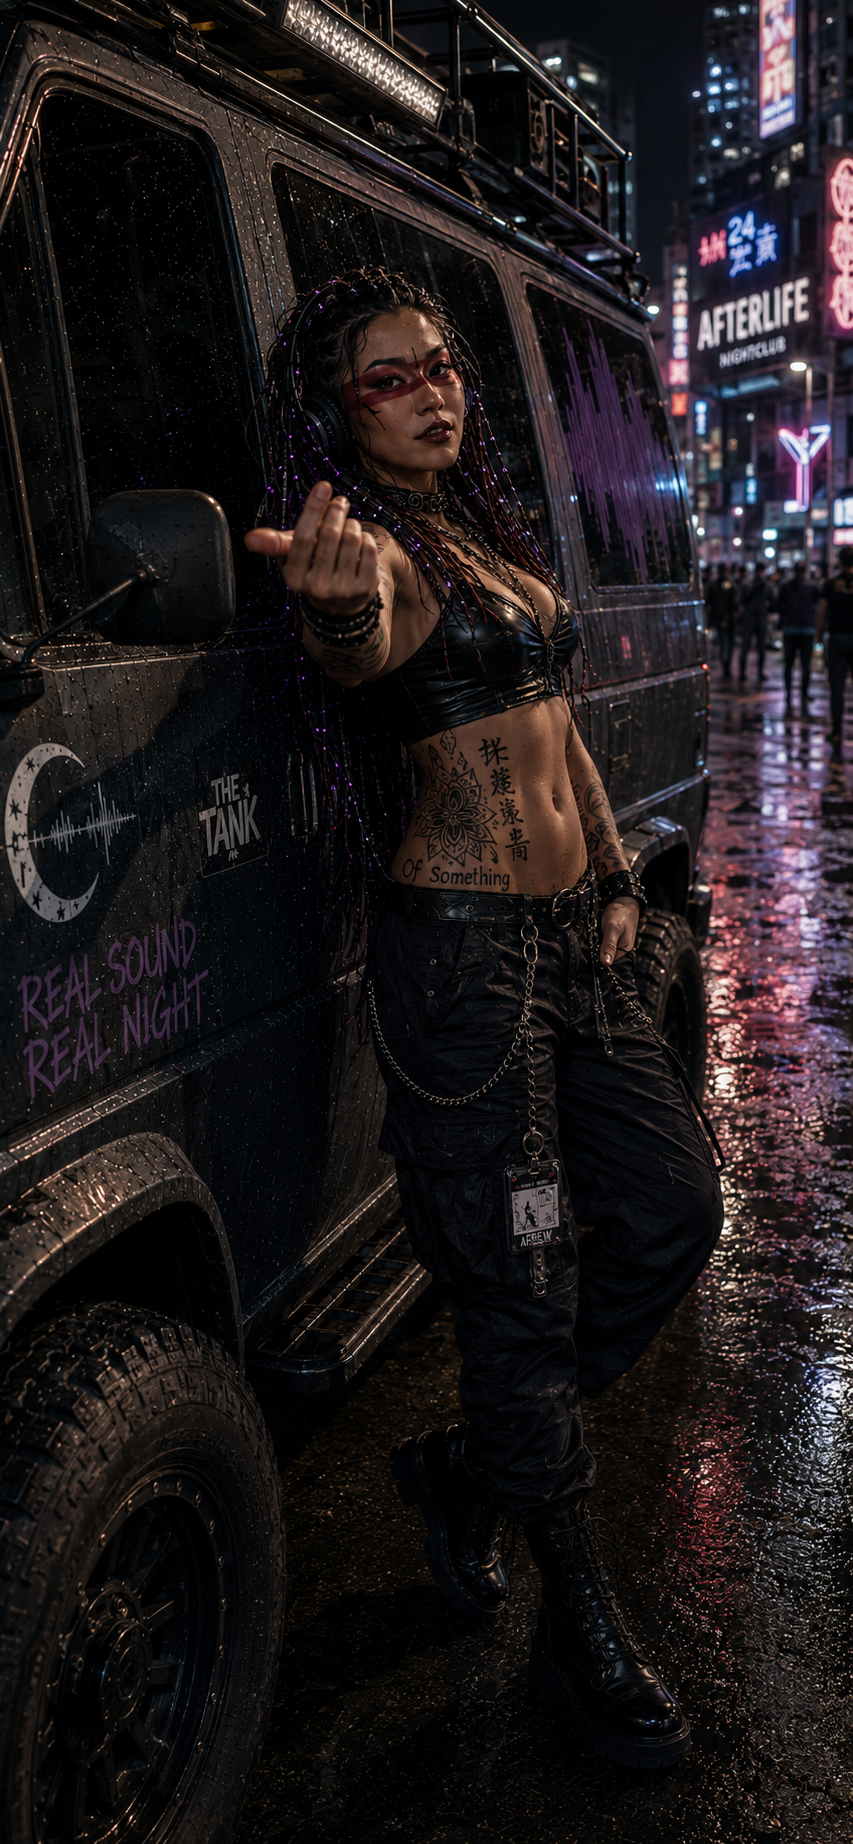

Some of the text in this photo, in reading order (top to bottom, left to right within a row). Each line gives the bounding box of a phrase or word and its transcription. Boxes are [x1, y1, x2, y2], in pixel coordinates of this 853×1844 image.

[728, 210, 757, 247] 24
[697, 276, 810, 351] AFTERLIFE
[211, 773, 241, 807] THE
[198, 794, 262, 857] TANK
[402, 858, 510, 892] Of Something
[16, 915, 198, 1033] REAL SOUND
[22, 969, 209, 1099] REAL NIGHT
